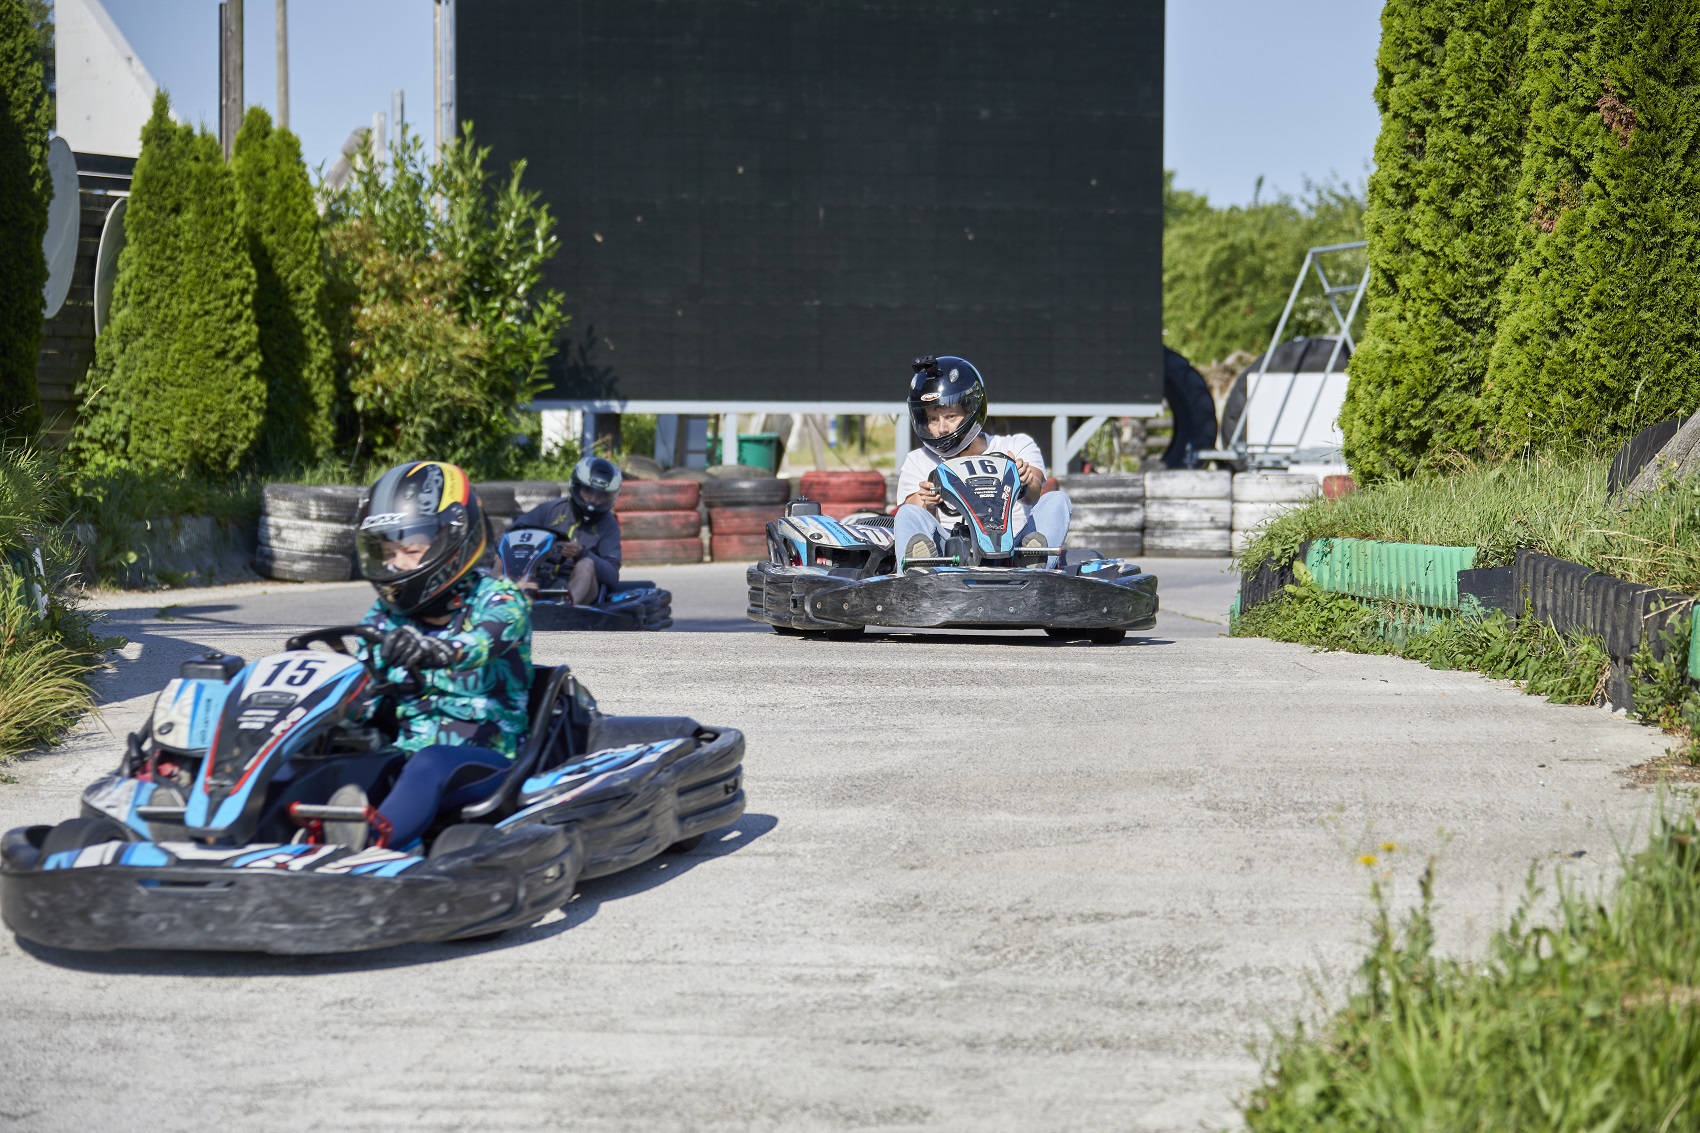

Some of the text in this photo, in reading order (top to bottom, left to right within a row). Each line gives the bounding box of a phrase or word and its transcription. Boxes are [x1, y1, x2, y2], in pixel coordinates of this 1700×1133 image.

[960, 459, 998, 476] 16
[519, 533, 533, 543] 9
[261, 660, 326, 687] 15
